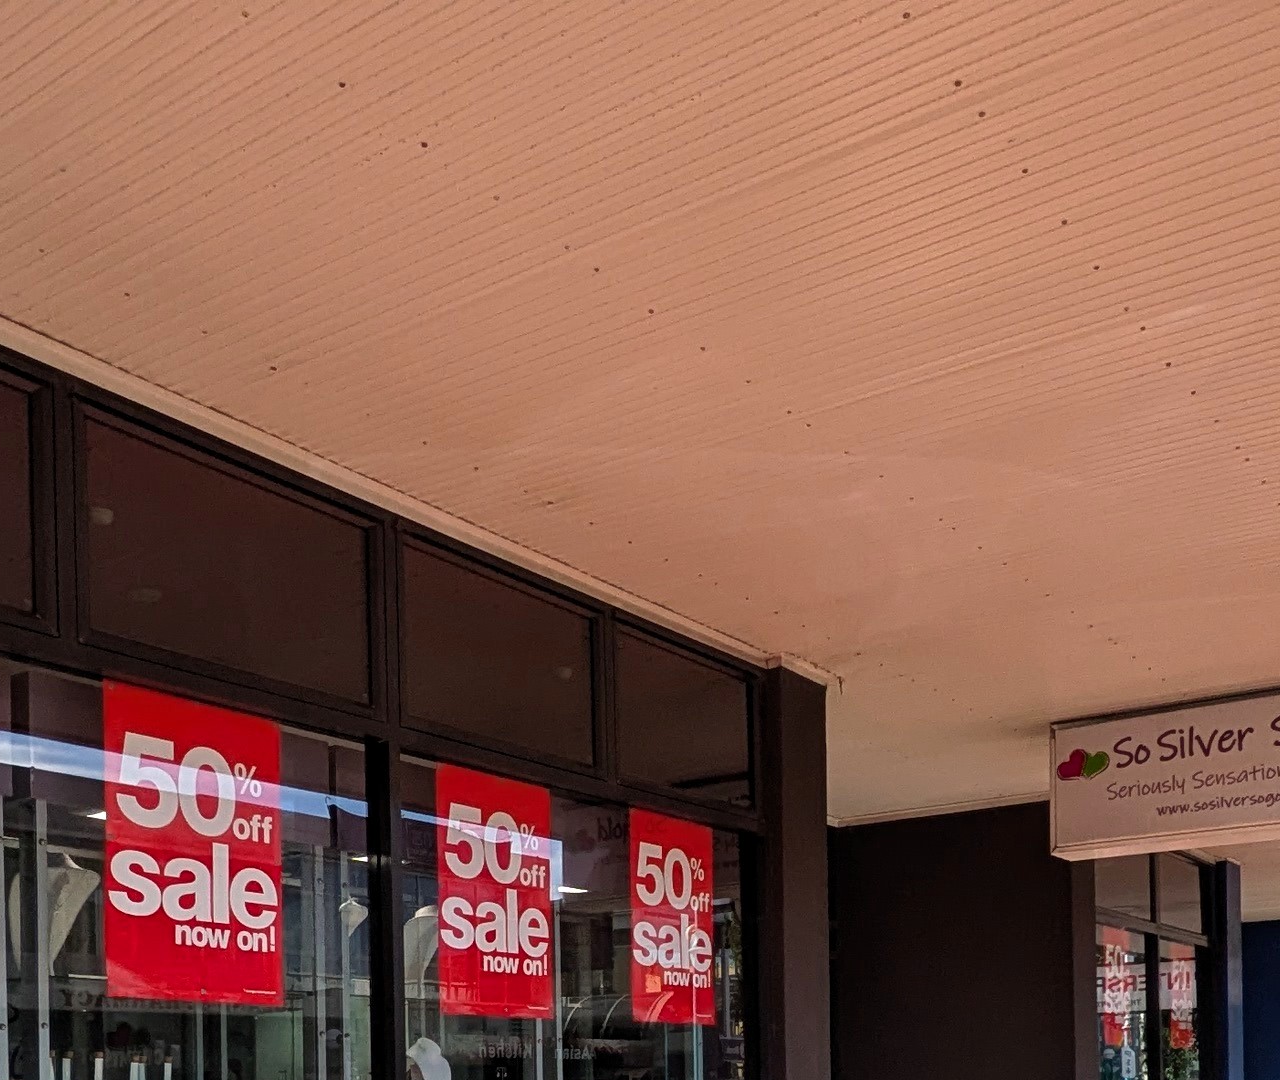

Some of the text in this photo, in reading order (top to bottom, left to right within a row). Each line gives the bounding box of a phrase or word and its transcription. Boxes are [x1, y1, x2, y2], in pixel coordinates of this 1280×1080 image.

[1113, 736, 1151, 769] So
[1156, 725, 1254, 762] Silver
[116, 731, 262, 837] 50%
[1106, 773, 1186, 801] Seriously
[232, 814, 273, 844] off
[444, 801, 539, 885] 50%
[108, 841, 278, 930] sale
[520, 864, 546, 889] off
[636, 841, 705, 910] 50%
[690, 892, 710, 913] off
[174, 924, 276, 953] now on!
[440, 887, 549, 958] sale
[633, 913, 713, 973] sale
[483, 954, 548, 977] now on!
[663, 969, 711, 989] now on!
